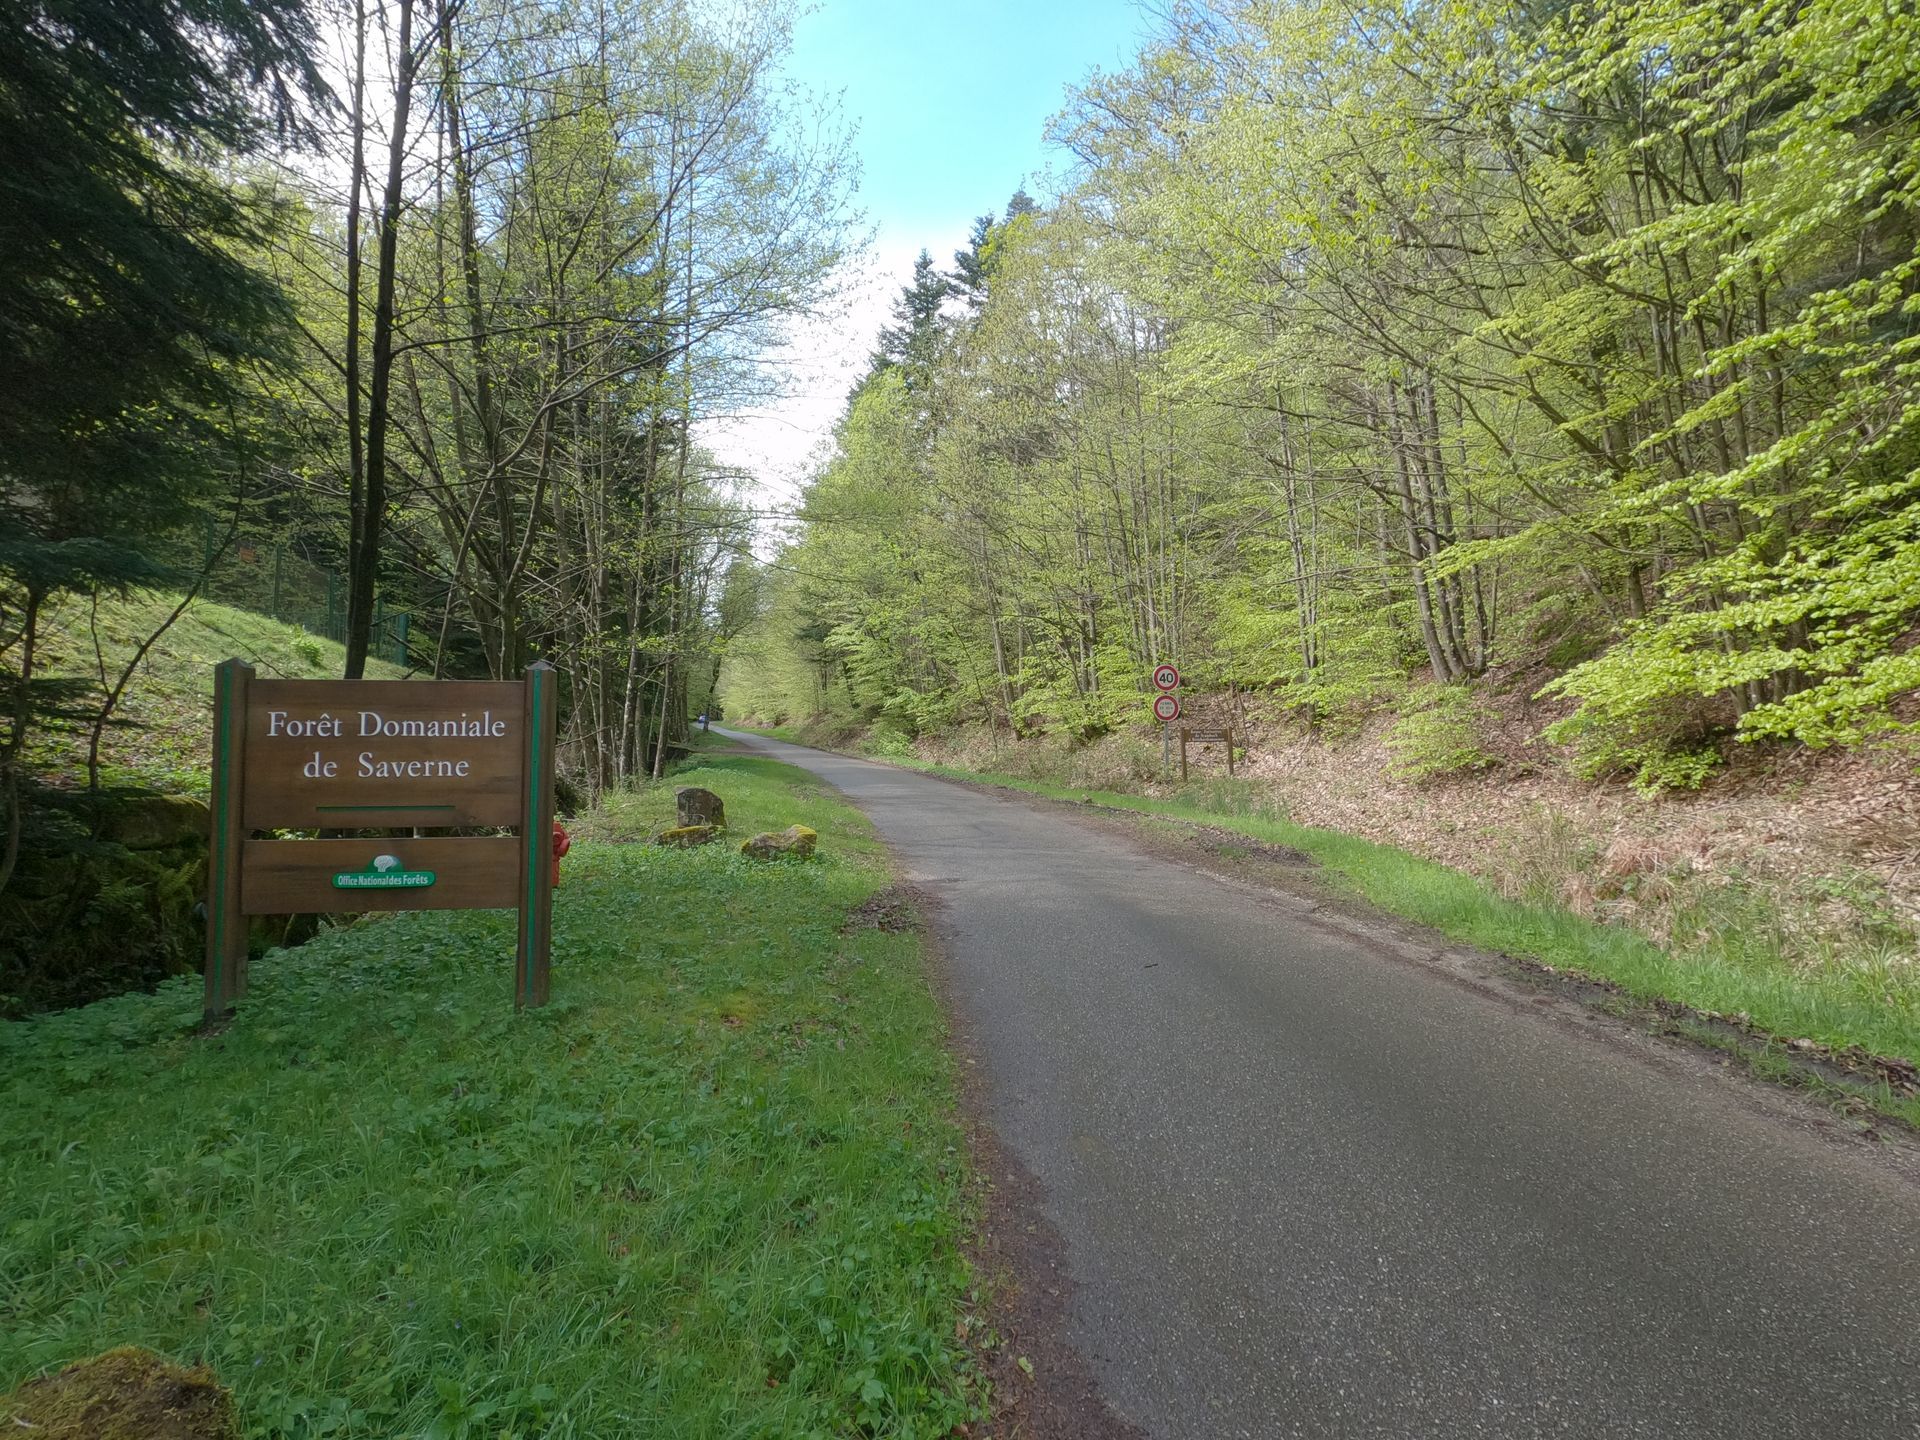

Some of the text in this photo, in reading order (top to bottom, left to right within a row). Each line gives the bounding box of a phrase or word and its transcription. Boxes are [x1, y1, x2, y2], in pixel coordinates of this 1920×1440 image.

[1159, 673, 1174, 683] 40
[267, 710, 506, 737] Forêt Domaniale
[303, 751, 470, 778] de Saverne
[338, 875, 357, 886] Office
[403, 874, 428, 884] Forêts
